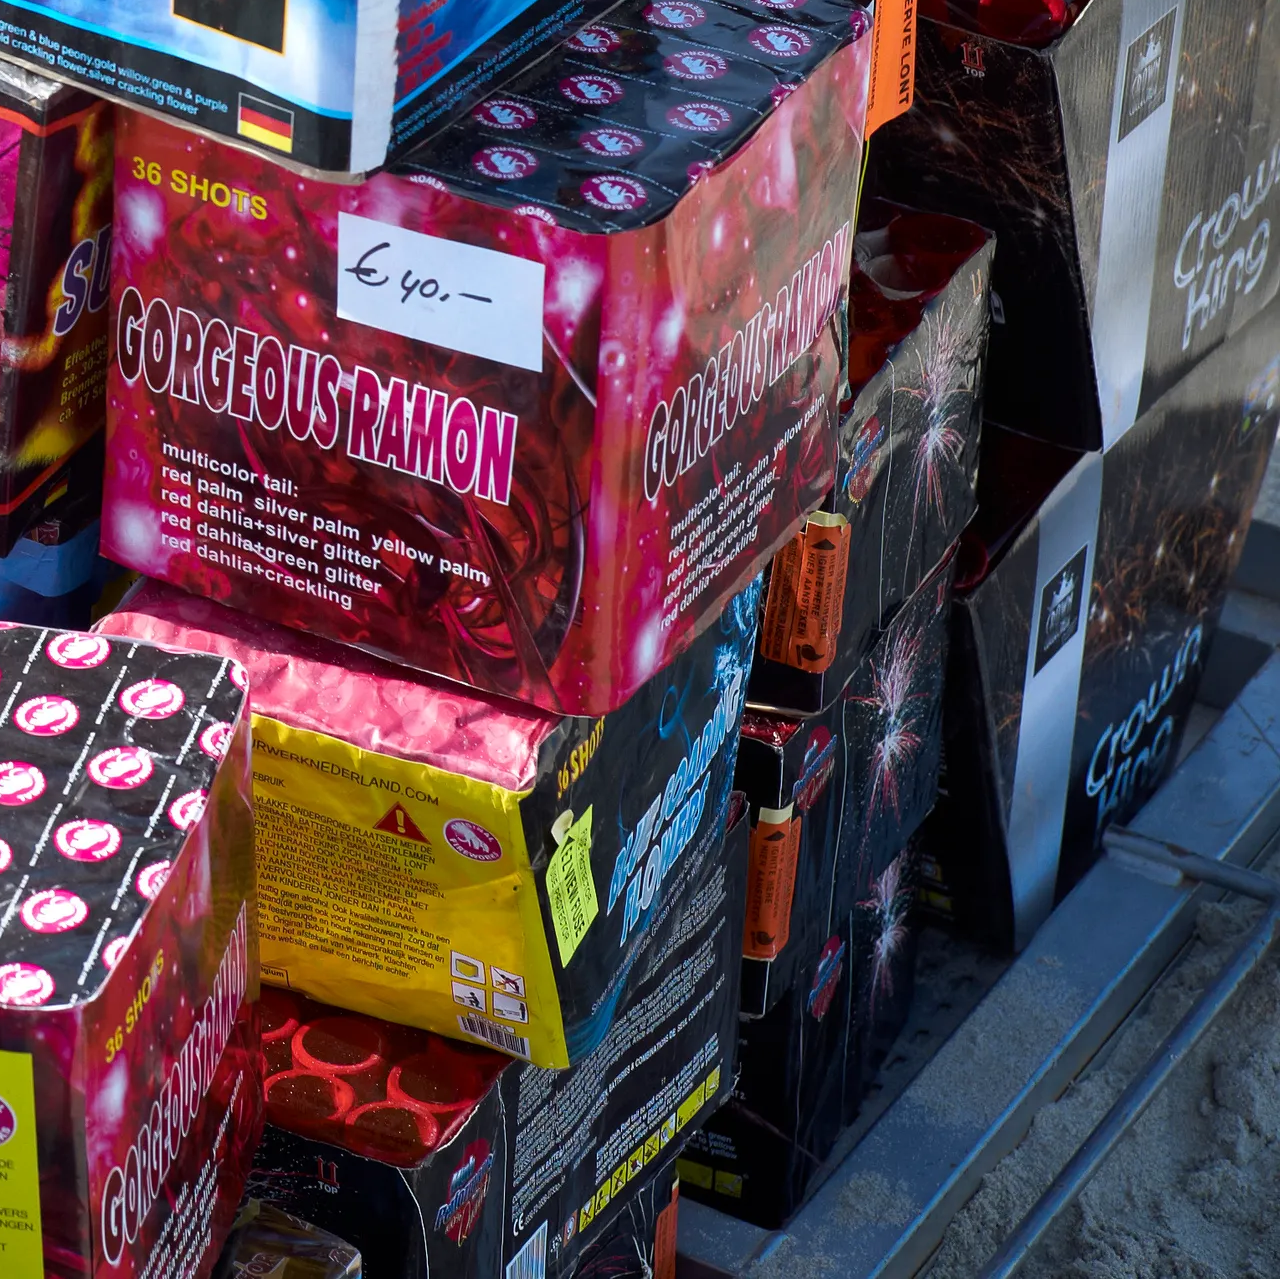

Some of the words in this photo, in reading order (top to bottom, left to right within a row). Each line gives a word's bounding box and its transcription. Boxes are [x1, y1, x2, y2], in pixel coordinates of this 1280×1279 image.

[897, 54, 912, 105] LONT
[131, 156, 162, 187] 36
[170, 169, 269, 221] SHOTS
[344, 242, 391, 286] €
[1182, 218, 1271, 351] King
[117, 286, 342, 450] GORGEOUS
[347, 365, 519, 507] RAMON
[643, 301, 773, 502] GORGEOUS
[769, 220, 850, 387] RAMON
[162, 439, 259, 484] multicolor
[263, 473, 299, 498] tail:
[669, 482, 722, 541] multicolor
[723, 462, 743, 495] tail:
[161, 463, 191, 486] red
[197, 476, 244, 504] palm
[254, 495, 308, 524] silver
[313, 515, 360, 542] palm
[371, 531, 434, 566] yellow
[161, 486, 191, 509] red
[196, 499, 319, 551] dahlia+silver
[323, 537, 381, 572] glitter
[161, 509, 191, 532] red
[196, 521, 319, 574] dahlia+green
[324, 560, 382, 596] glitter
[161, 532, 191, 554] red
[196, 542, 353, 611] dahlia+crackling
[805, 550, 816, 575] HIER
[817, 553, 828, 589] IGNITE
[811, 589, 823, 618] HERE
[1086, 623, 1203, 797] Crown
[570, 715, 606, 782] SHOTS
[561, 846, 573, 873] EZ
[564, 862, 579, 904] VIEW
[571, 899, 586, 938] FUSE
[105, 1025, 124, 1064] 36
[125, 947, 165, 1035] SHOTS
[101, 1020, 202, 1266] GORGEOUS
